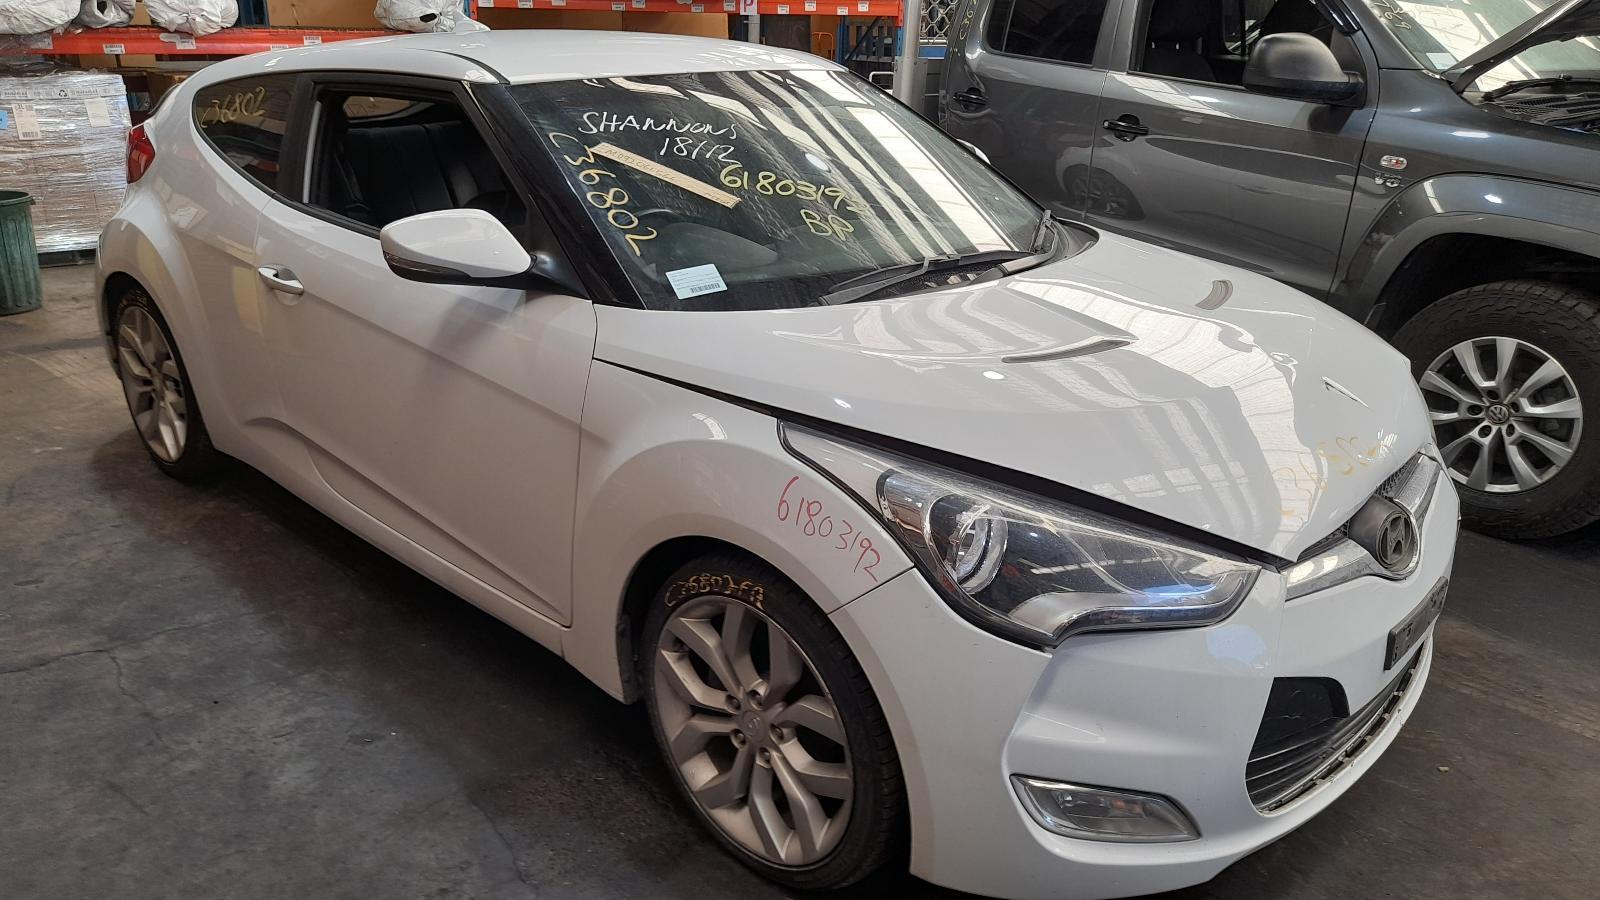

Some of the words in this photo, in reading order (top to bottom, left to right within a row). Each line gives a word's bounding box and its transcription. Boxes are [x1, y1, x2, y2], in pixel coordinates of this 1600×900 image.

[548, 131, 657, 256] C36802
[660, 137, 743, 163] 18/12
[777, 476, 881, 583] 61803192
